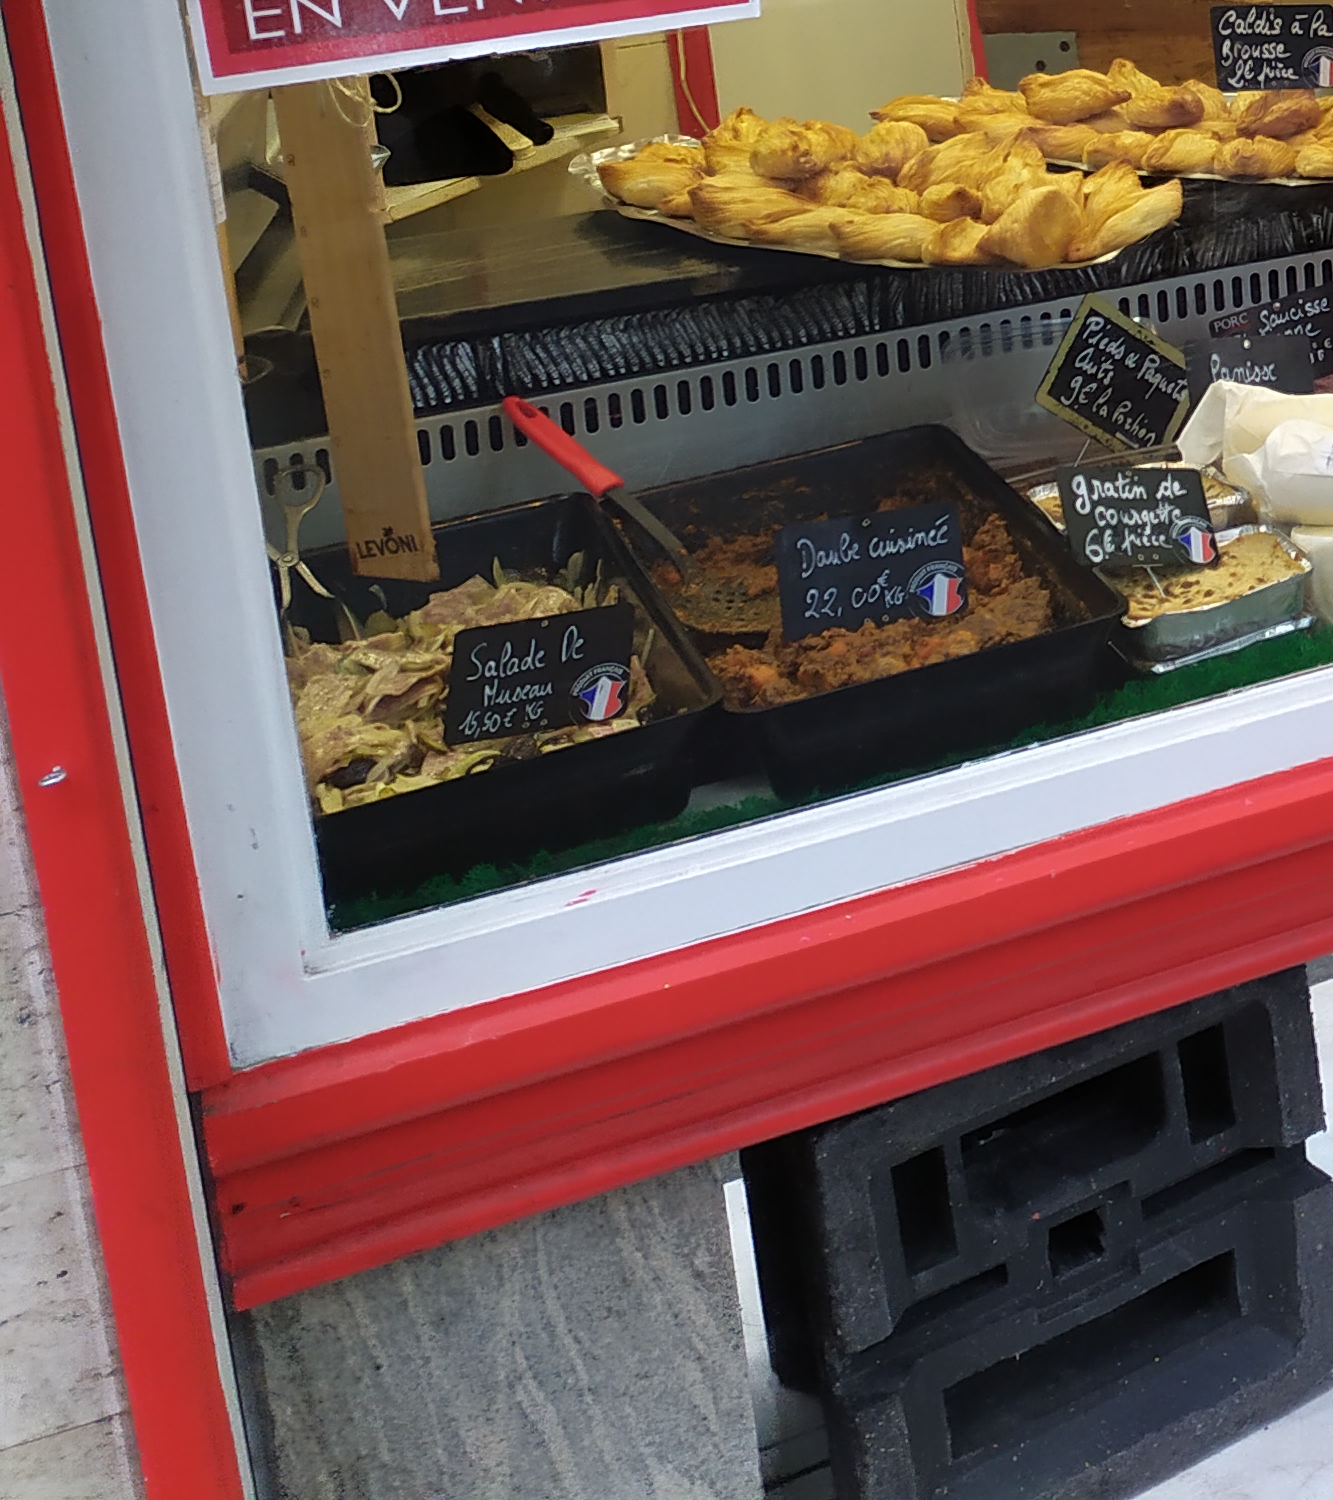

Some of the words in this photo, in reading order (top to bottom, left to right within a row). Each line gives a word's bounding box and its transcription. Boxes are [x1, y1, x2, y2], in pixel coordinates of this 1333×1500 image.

[1220, 38, 1292, 67] Brousse
[1213, 312, 1250, 333] PORC
[1258, 297, 1331, 335] Saucisse
[1078, 313, 1127, 361] Pieds
[1137, 353, 1189, 402] Paquets
[1156, 472, 1188, 500] de
[355, 534, 420, 561] LEVONI
[796, 532, 861, 579] Daube
[466, 637, 547, 683] Salade
